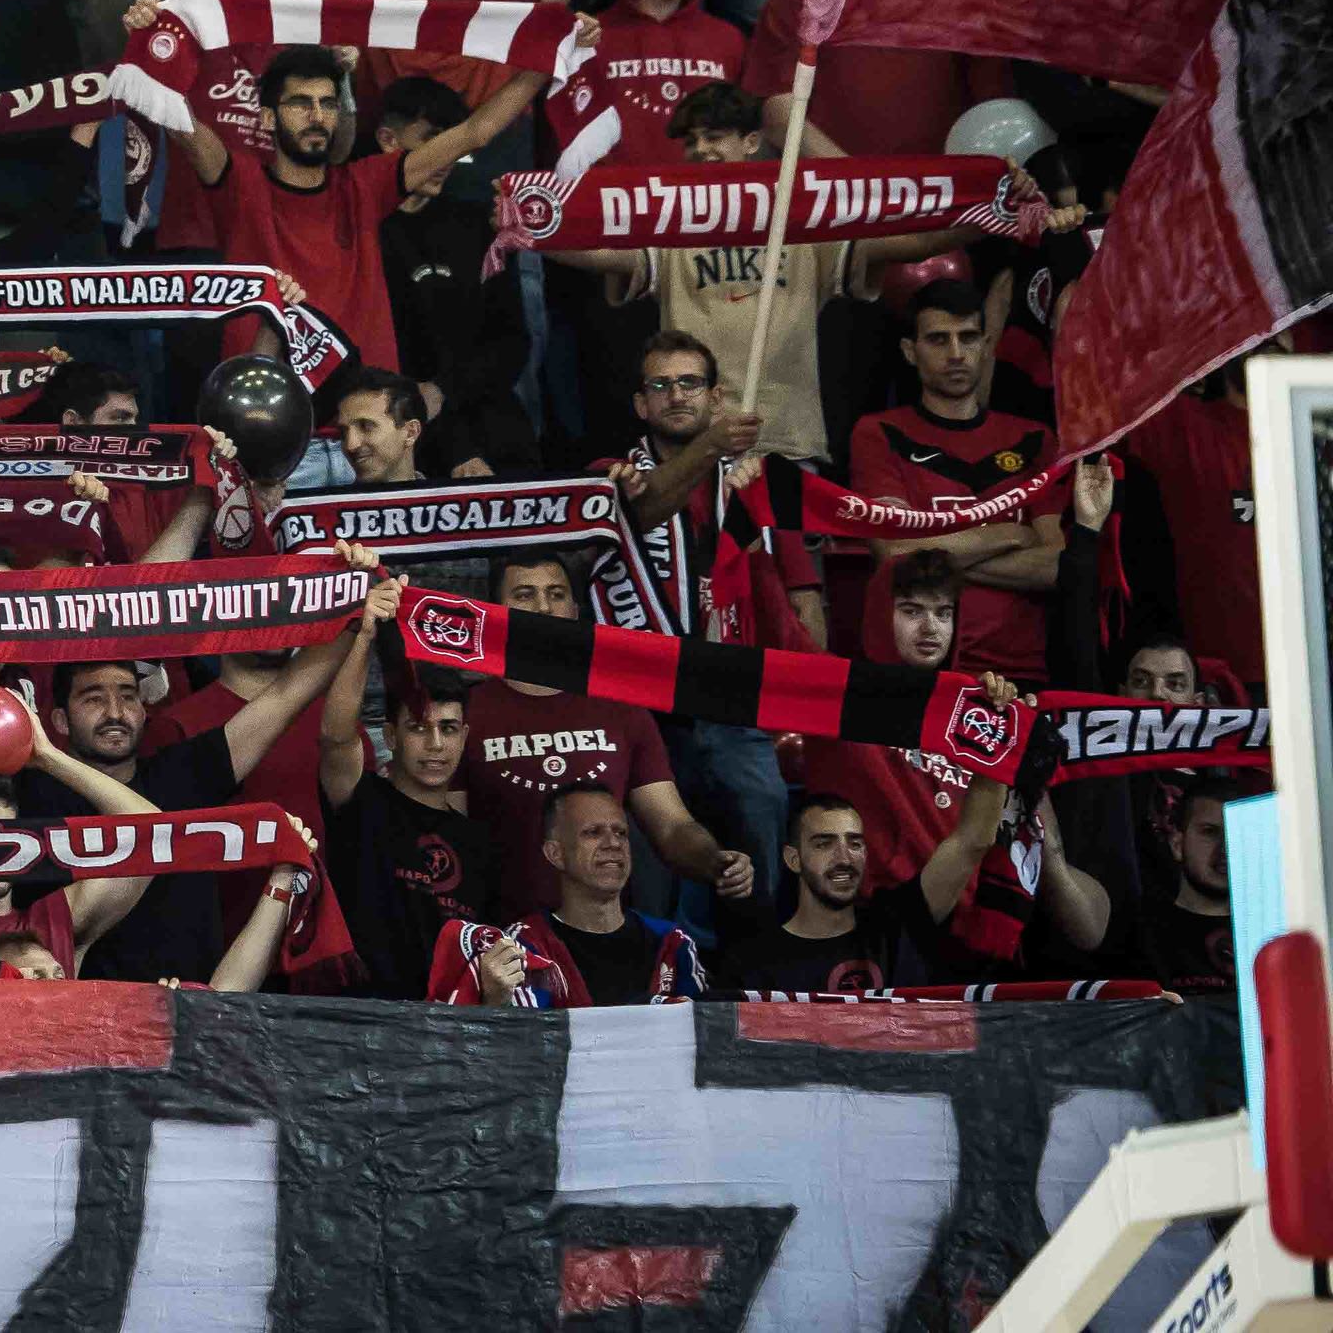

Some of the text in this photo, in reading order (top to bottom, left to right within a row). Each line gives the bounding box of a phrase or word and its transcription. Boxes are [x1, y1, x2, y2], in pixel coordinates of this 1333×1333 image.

[600, 168, 954, 239] הפועל רושלים
[72, 276, 185, 306] MALAGA
[191, 277, 264, 305] 2023
[335, 494, 570, 539] JERUSALEM
[56, 588, 159, 632] מחזיקת
[171, 580, 279, 625] ירושלים
[287, 570, 370, 615] הפועל
[483, 727, 618, 764] HAPOEL
